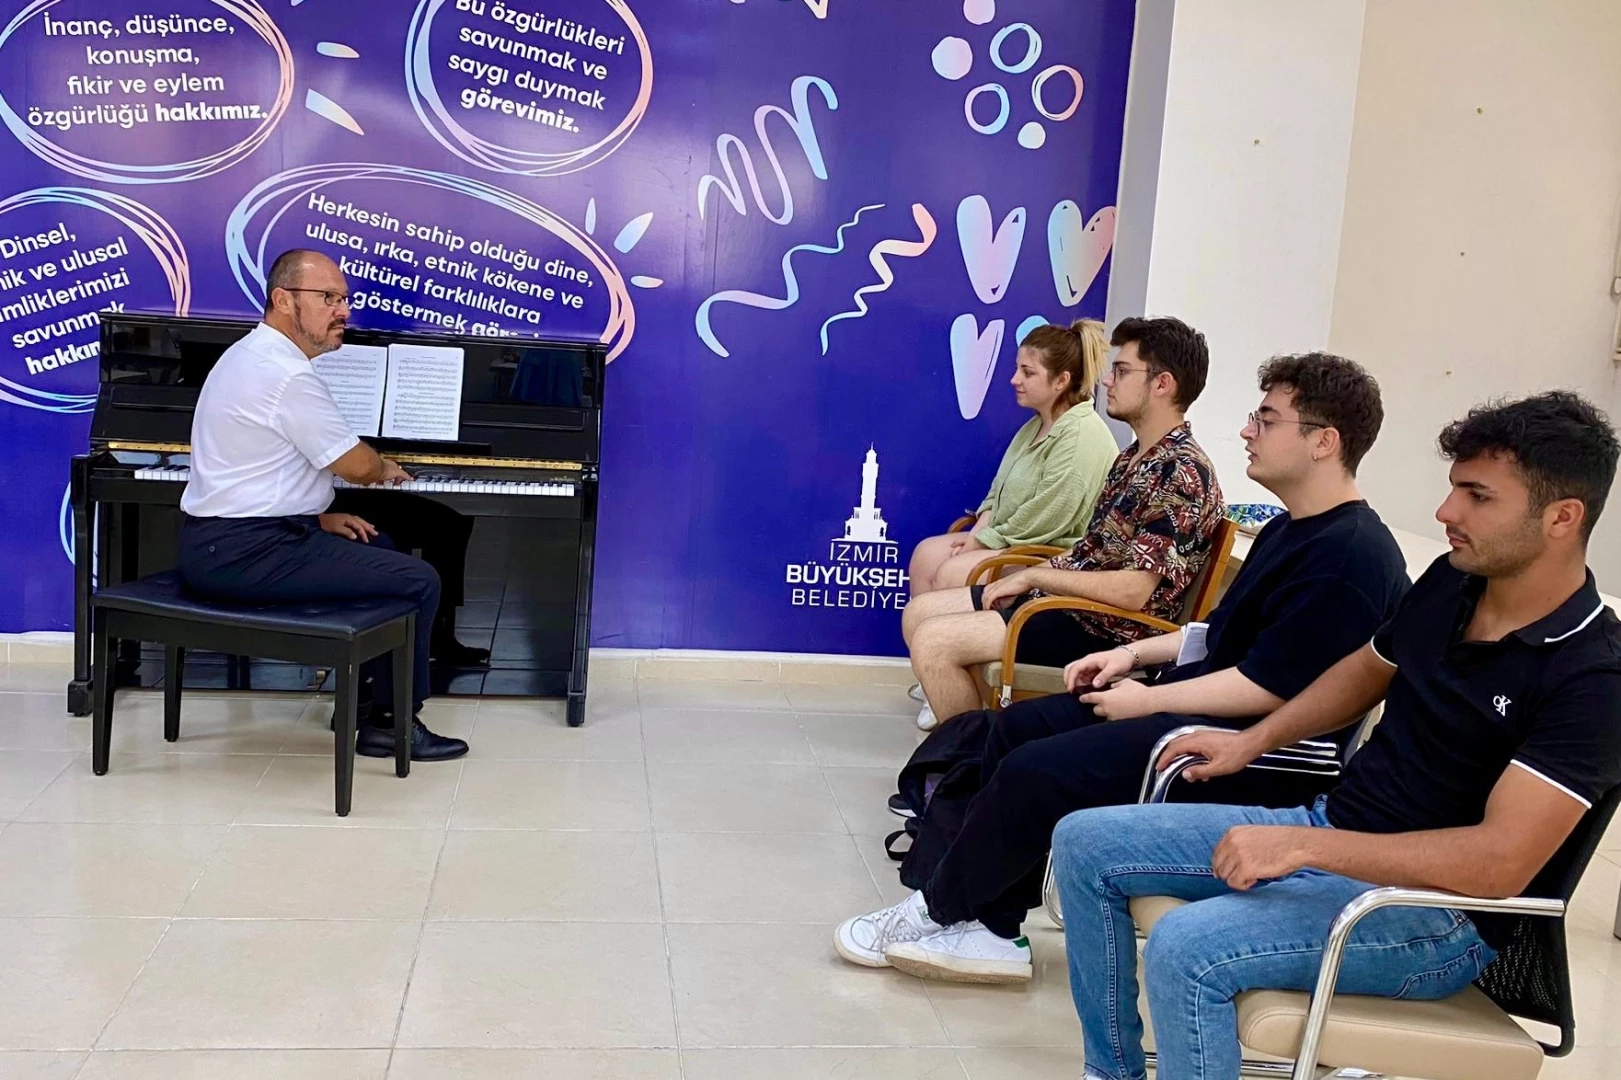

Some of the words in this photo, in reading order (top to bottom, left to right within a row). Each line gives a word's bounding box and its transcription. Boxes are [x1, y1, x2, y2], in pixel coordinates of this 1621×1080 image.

[43, 12, 120, 38] İnanç,
[125, 14, 235, 39] düşünce,
[456, 0, 485, 16] Bu
[490, 2, 626, 56] özgürlükleri
[86, 45, 200, 67] konuşma,
[459, 27, 577, 73] savunmak
[582, 60, 608, 81] ve
[67, 75, 113, 95] fikir
[119, 78, 147, 94] ve
[154, 73, 225, 97] eylem
[448, 54, 509, 86] saygı
[514, 71, 606, 111] duymak
[27, 104, 149, 131] özgürlüğü
[155, 102, 268, 123] hakkımız.
[460, 88, 580, 134] görevimiz.
[0, 222, 77, 259] Dinsel,
[28, 262, 58, 281] ve
[60, 236, 129, 272] ulusal
[307, 192, 400, 233] Herkesin
[405, 220, 465, 252] sahip
[469, 235, 540, 272] olduğu
[544, 254, 594, 288] dine,
[305, 222, 368, 254] ulusa,
[373, 241, 419, 267] ırka,
[424, 254, 478, 282] etnik
[482, 266, 556, 302] kökene
[560, 290, 585, 309] ve
[339, 255, 420, 293] kültürel
[423, 278, 542, 325] farklılıklara
[791, 586, 912, 610] BELEDİYE
